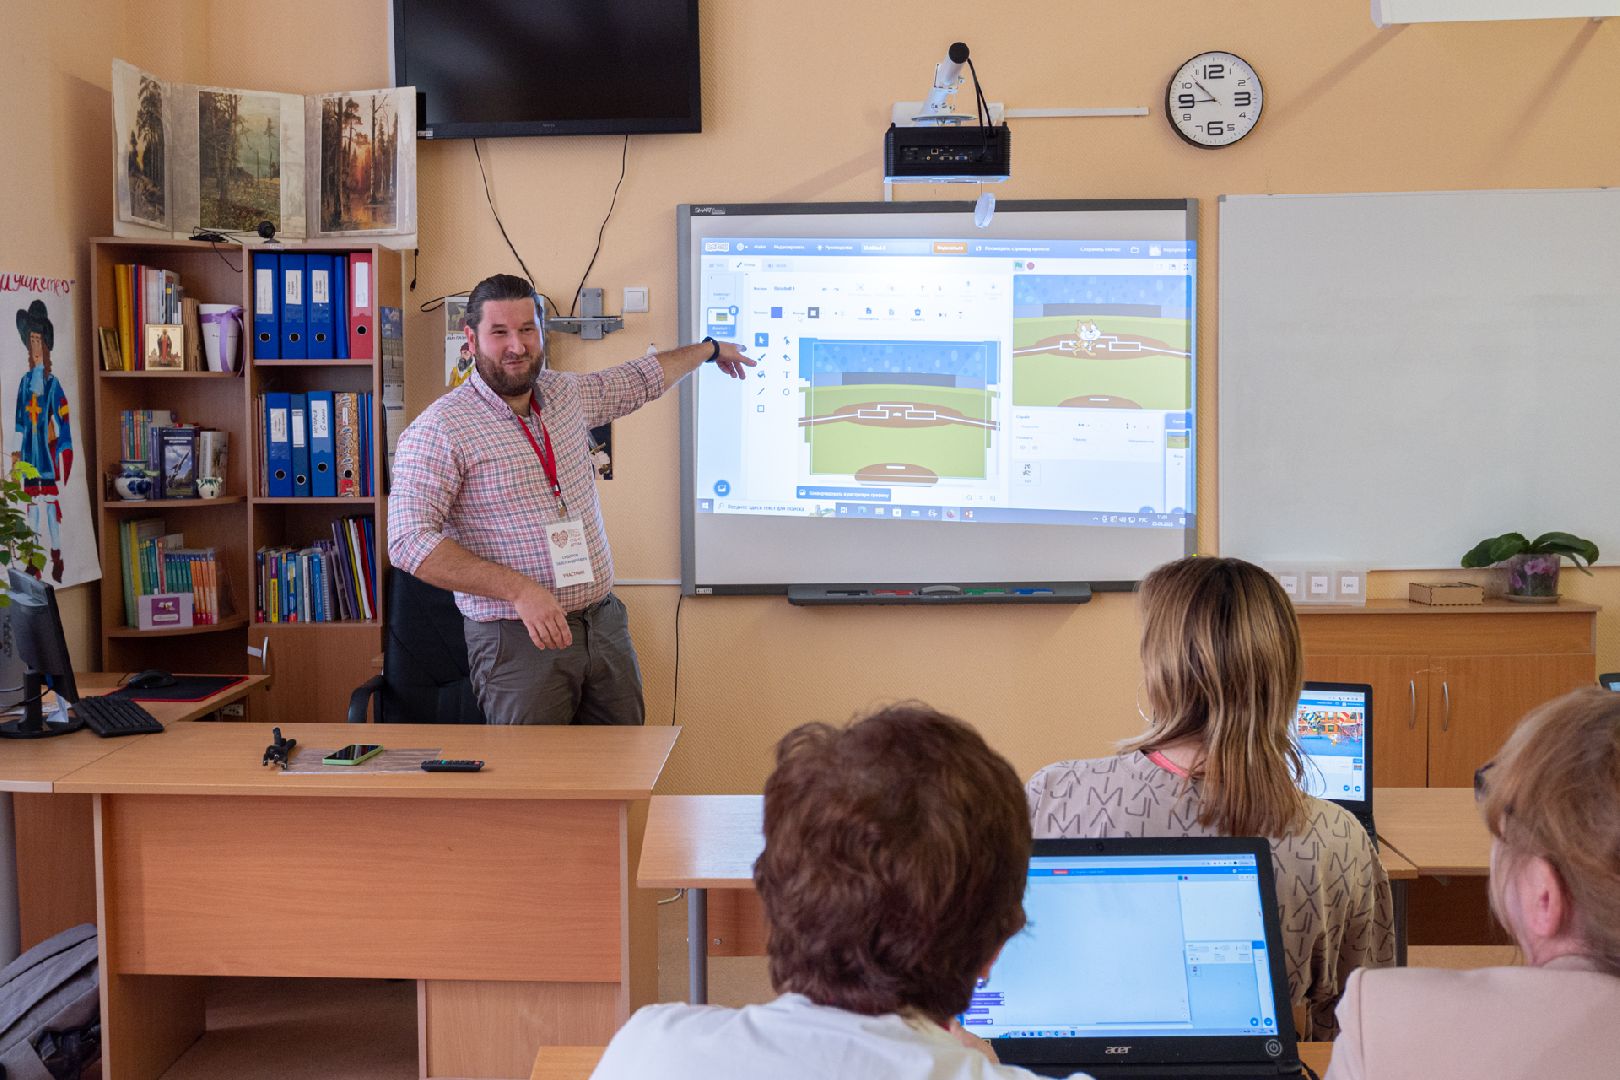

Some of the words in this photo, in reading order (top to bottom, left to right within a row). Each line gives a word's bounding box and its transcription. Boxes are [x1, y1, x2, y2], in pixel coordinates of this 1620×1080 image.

[1203, 64, 1225, 80] 12
[1237, 79, 1246, 87] 2
[1178, 93, 1195, 109] 9
[1234, 91, 1251, 107] 3
[1183, 113, 1192, 121] 8
[1195, 125, 1203, 133] 7
[1207, 121, 1223, 135] 6
[1105, 1046, 1132, 1054] acer
